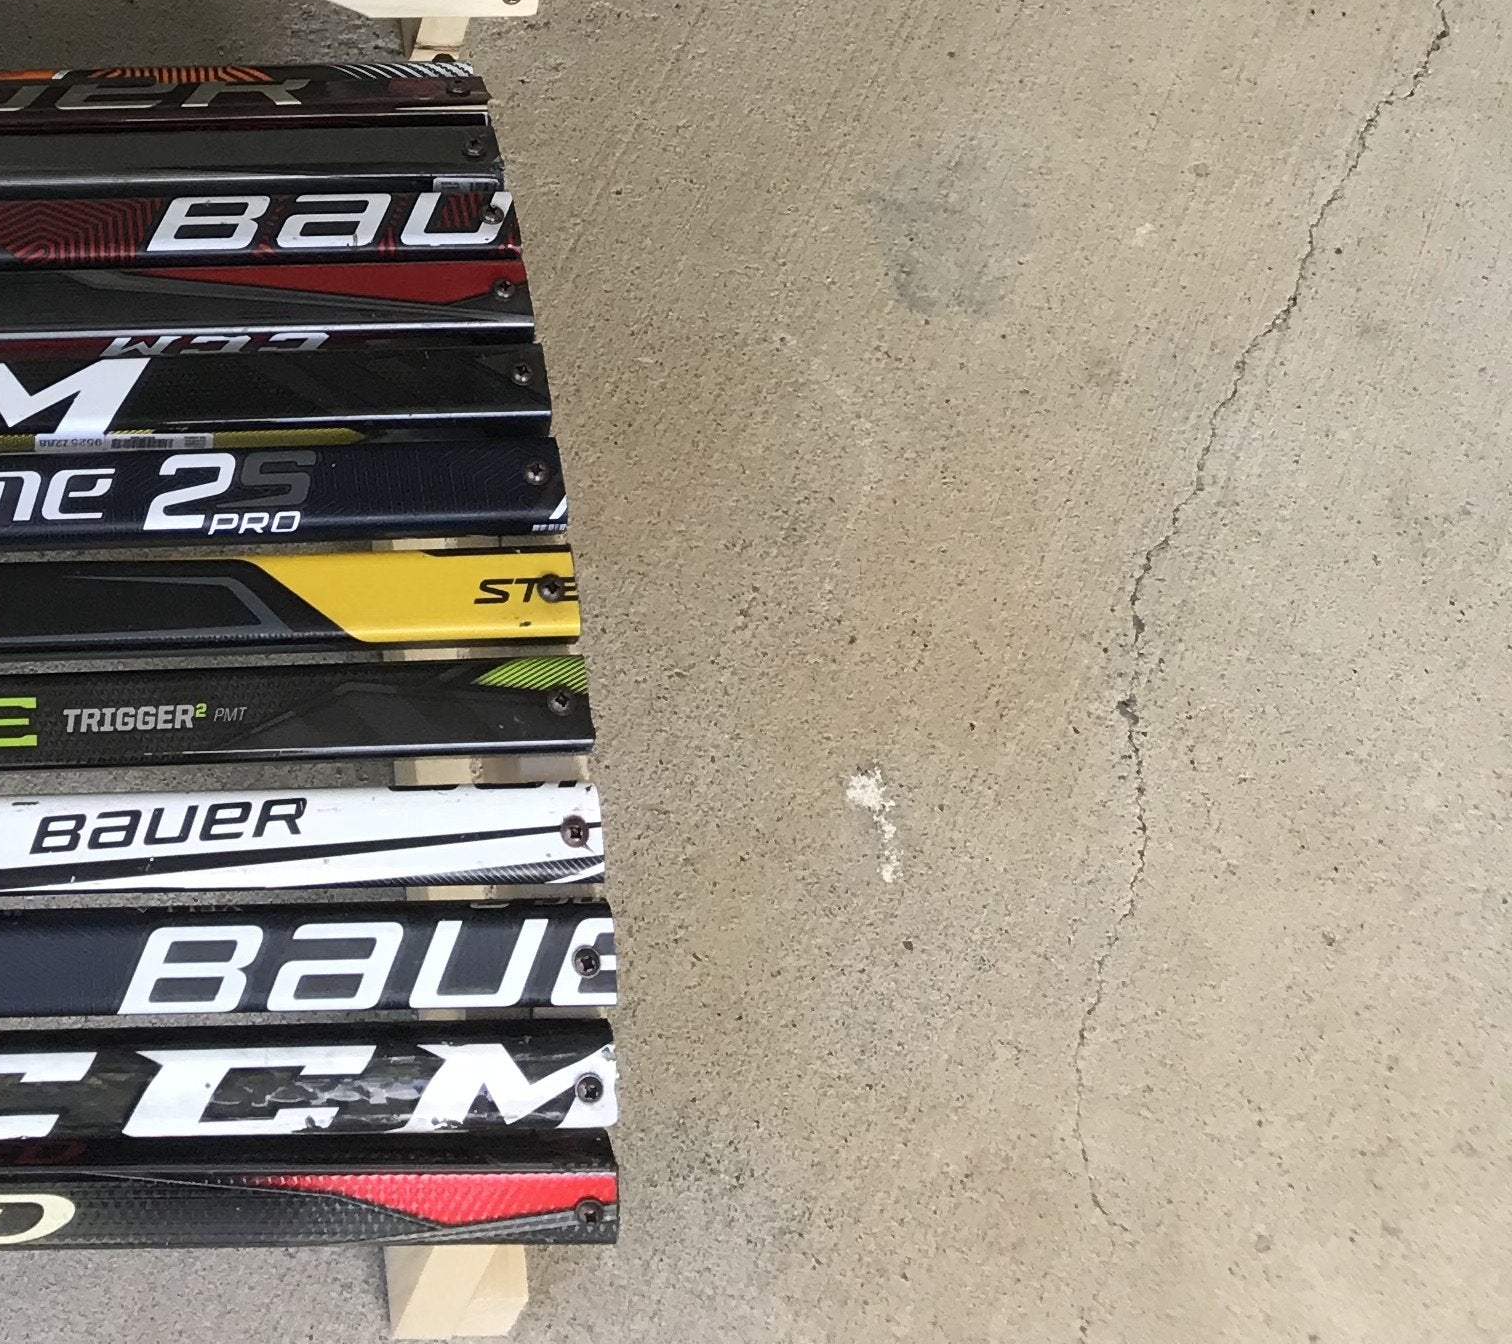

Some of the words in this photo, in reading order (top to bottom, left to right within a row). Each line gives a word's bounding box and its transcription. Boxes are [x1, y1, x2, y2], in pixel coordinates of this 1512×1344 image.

[207, 508, 302, 536] PRO
[213, 706, 249, 724] PMT
[28, 797, 308, 856] BAUER
